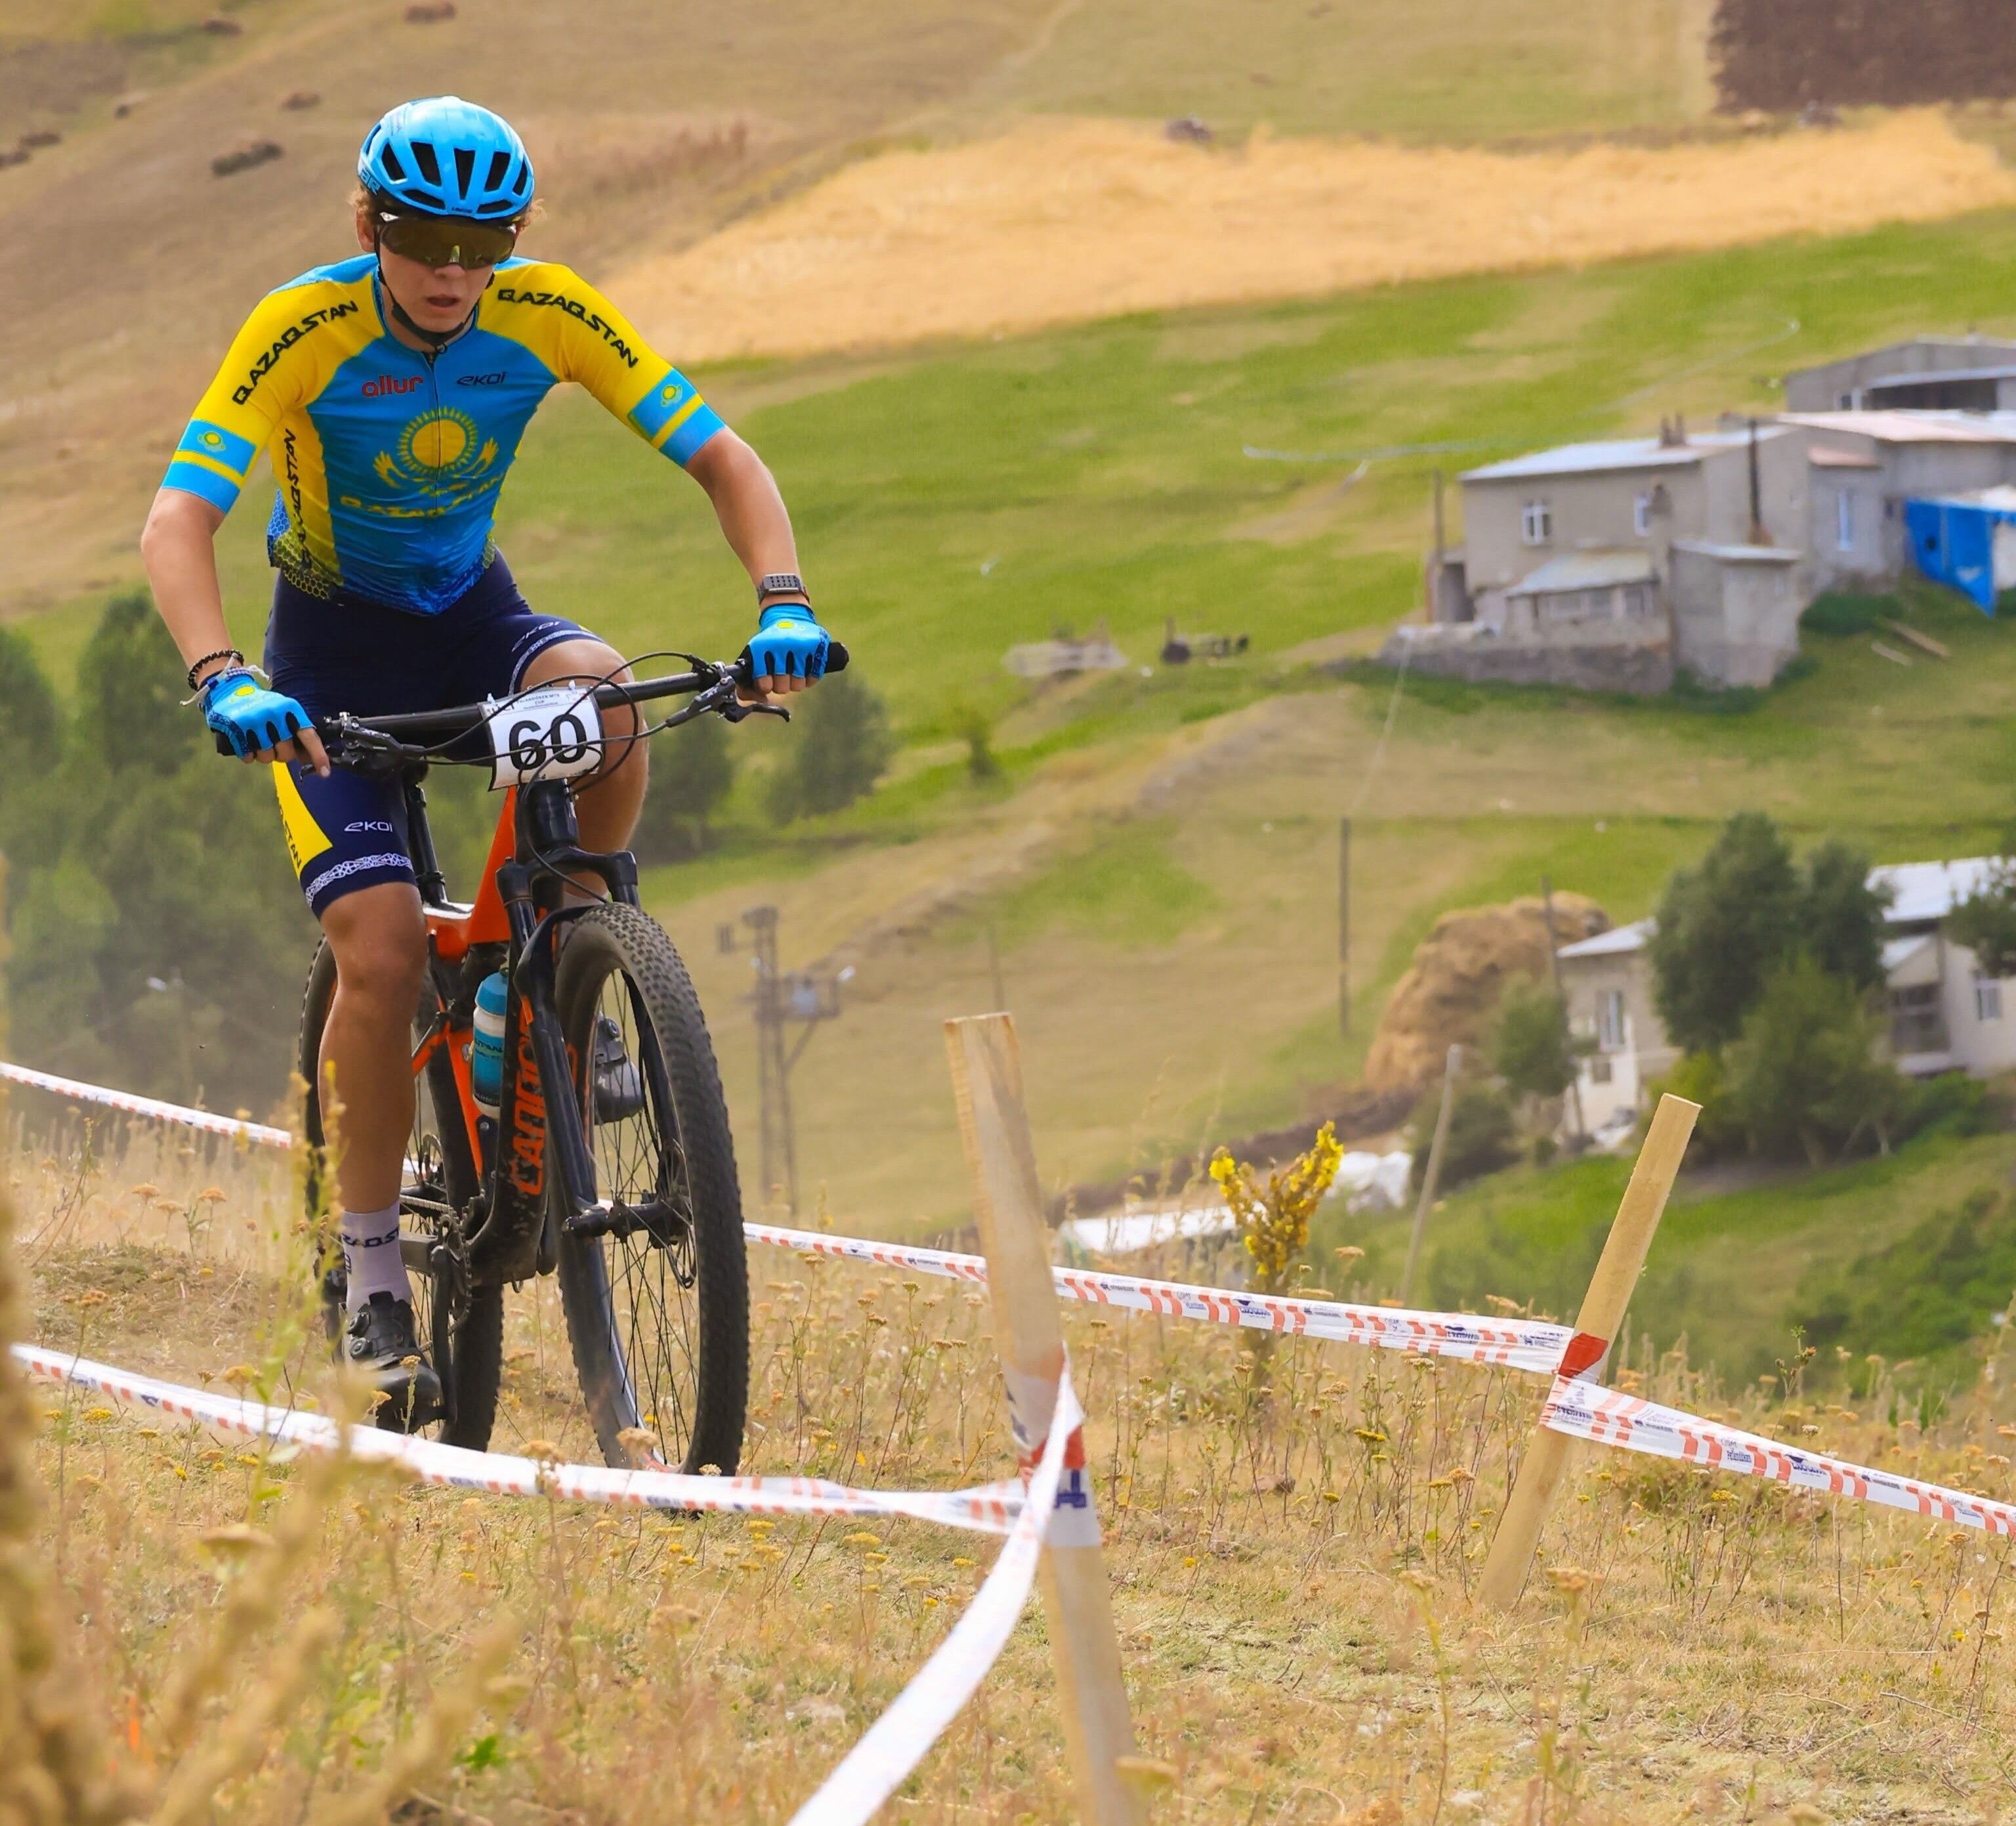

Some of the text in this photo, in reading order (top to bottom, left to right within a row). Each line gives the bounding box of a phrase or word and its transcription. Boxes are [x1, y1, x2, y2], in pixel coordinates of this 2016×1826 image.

[232, 300, 358, 406] QAZAQSTAN
[498, 289, 639, 368] QAZAQSTAN
[362, 374, 424, 398] allur
[509, 713, 587, 770] 60
